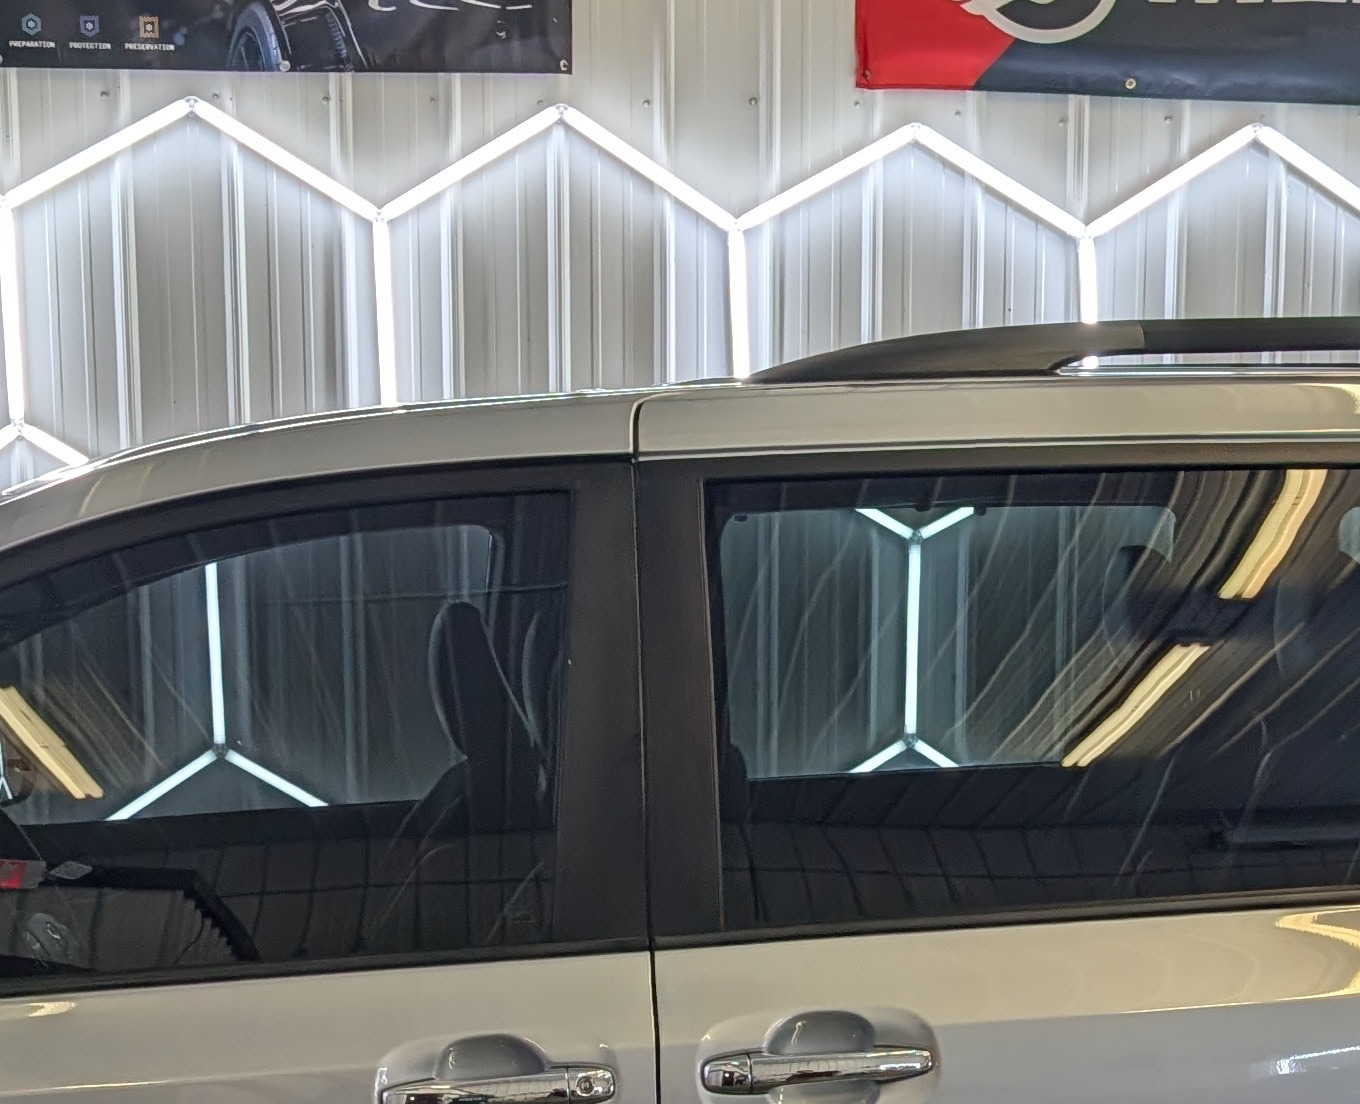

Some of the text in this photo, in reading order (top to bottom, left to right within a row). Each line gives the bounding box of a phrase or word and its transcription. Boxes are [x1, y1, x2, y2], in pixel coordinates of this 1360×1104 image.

[8, 40, 56, 48] PREPARATION
[68, 42, 112, 50] PROTECTION
[124, 42, 175, 51] PRESERVATION
